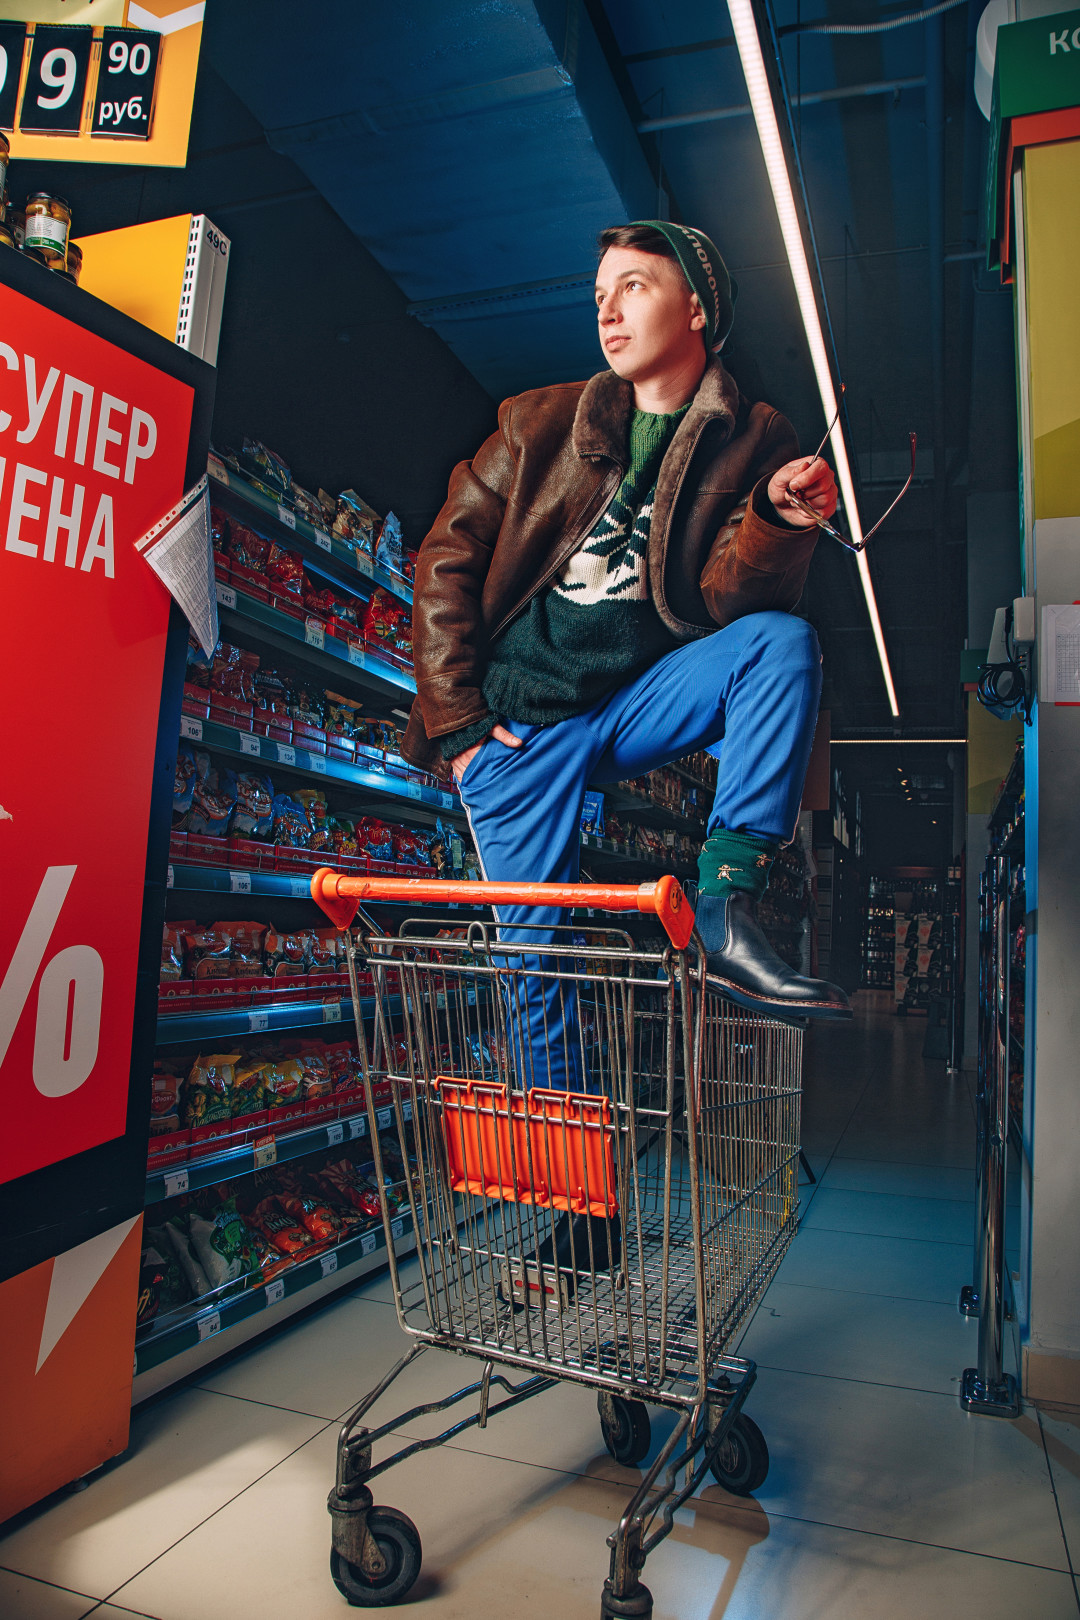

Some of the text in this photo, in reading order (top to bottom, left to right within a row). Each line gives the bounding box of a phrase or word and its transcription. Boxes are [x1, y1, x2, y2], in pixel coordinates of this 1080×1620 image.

[108, 41, 151, 76] 90
[98, 96, 148, 126] руб.
[0, 457, 116, 580] ЕНА
[222, 593, 232, 604] 143
[284, 753, 293, 761] 134
[177, 1181, 185, 1190] 74
